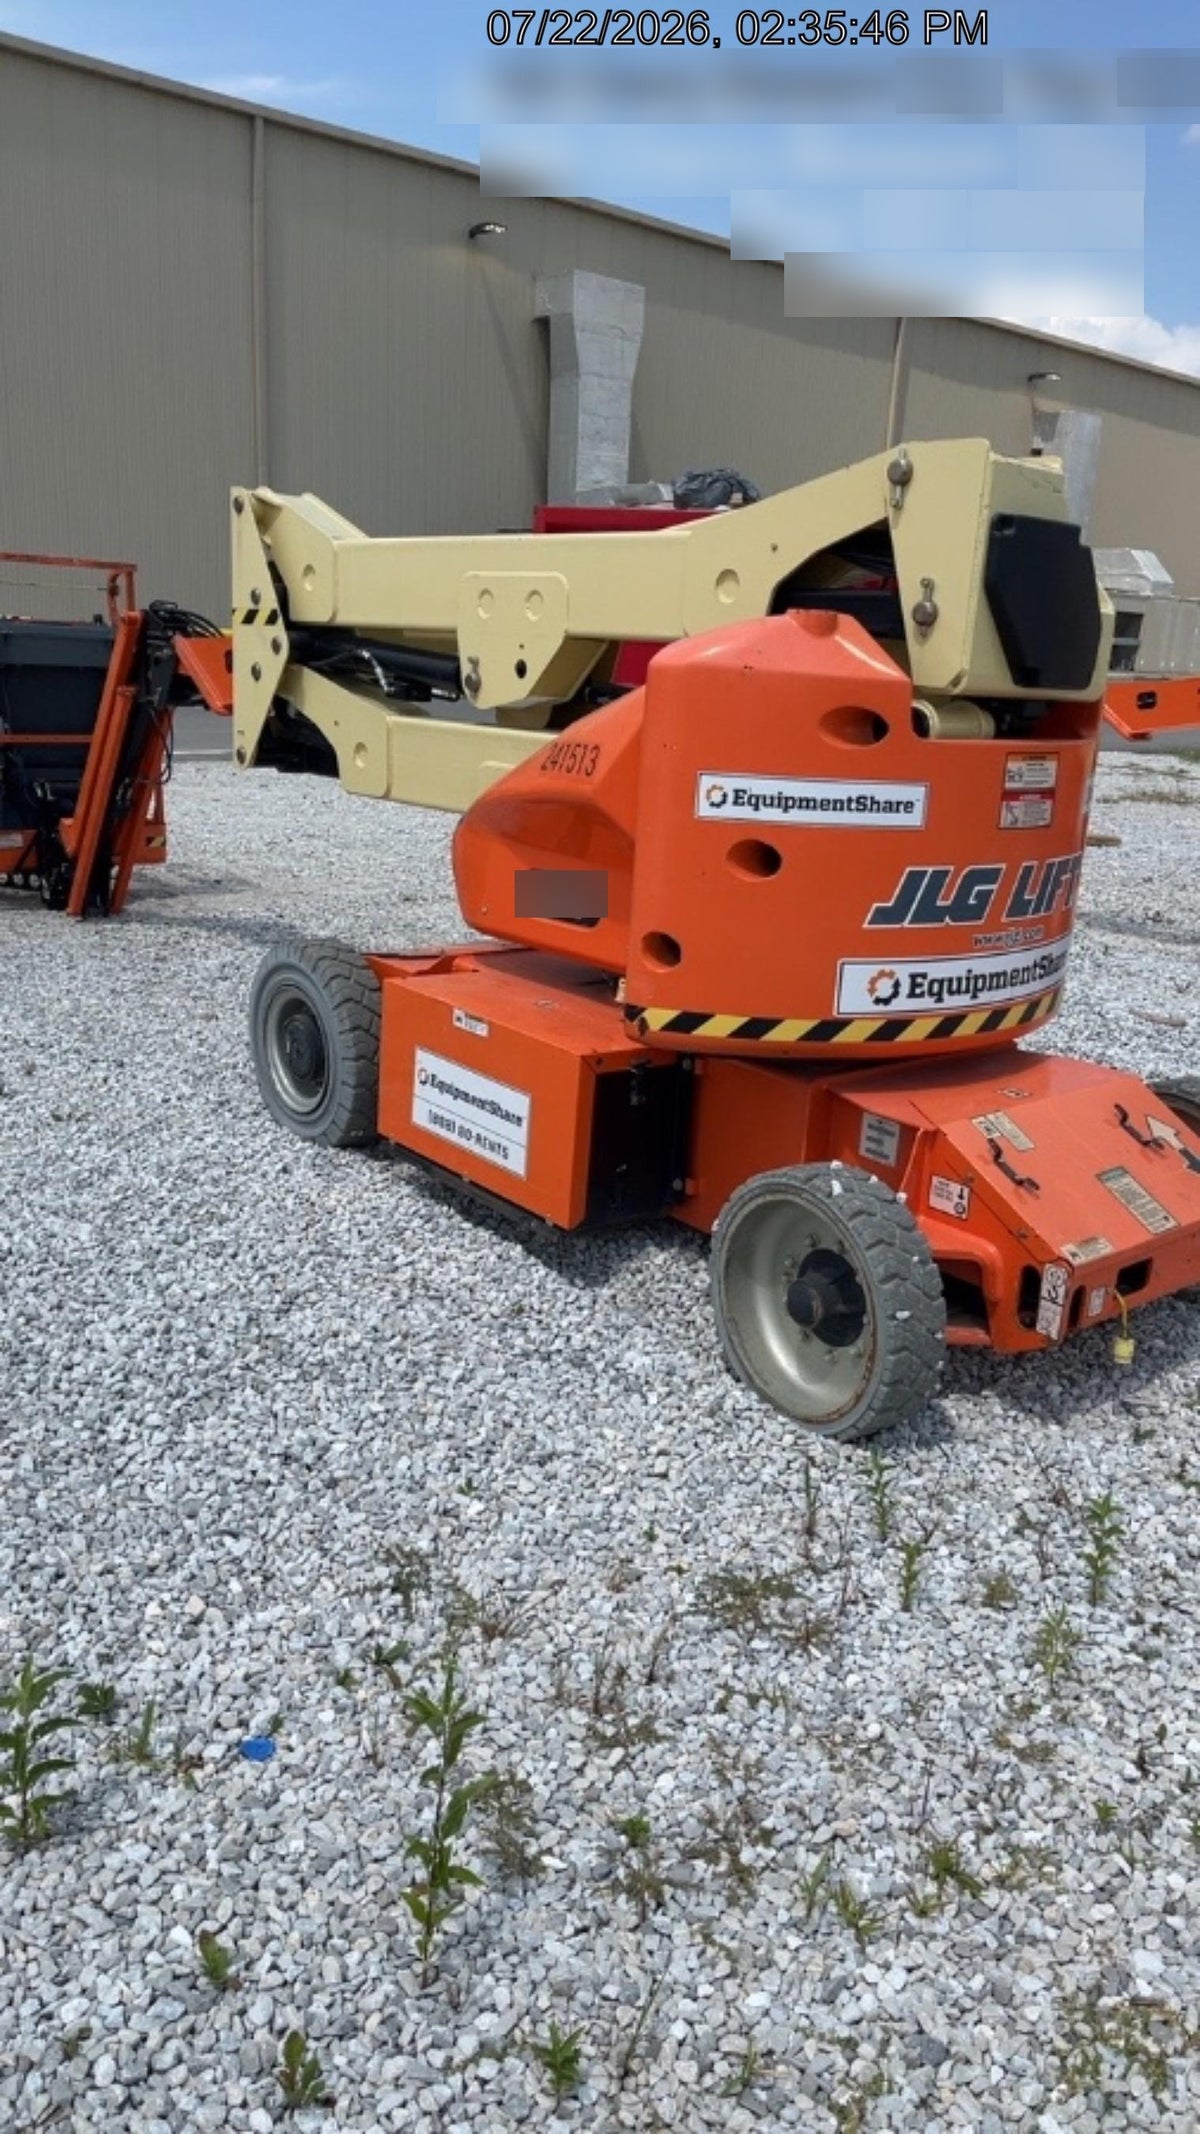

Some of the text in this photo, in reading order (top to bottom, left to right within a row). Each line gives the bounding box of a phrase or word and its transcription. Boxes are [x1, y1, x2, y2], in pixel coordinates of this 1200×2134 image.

[541, 743, 600, 777] 241513
[732, 788, 914, 814] EquipmentShare
[863, 865, 1006, 929] JLG
